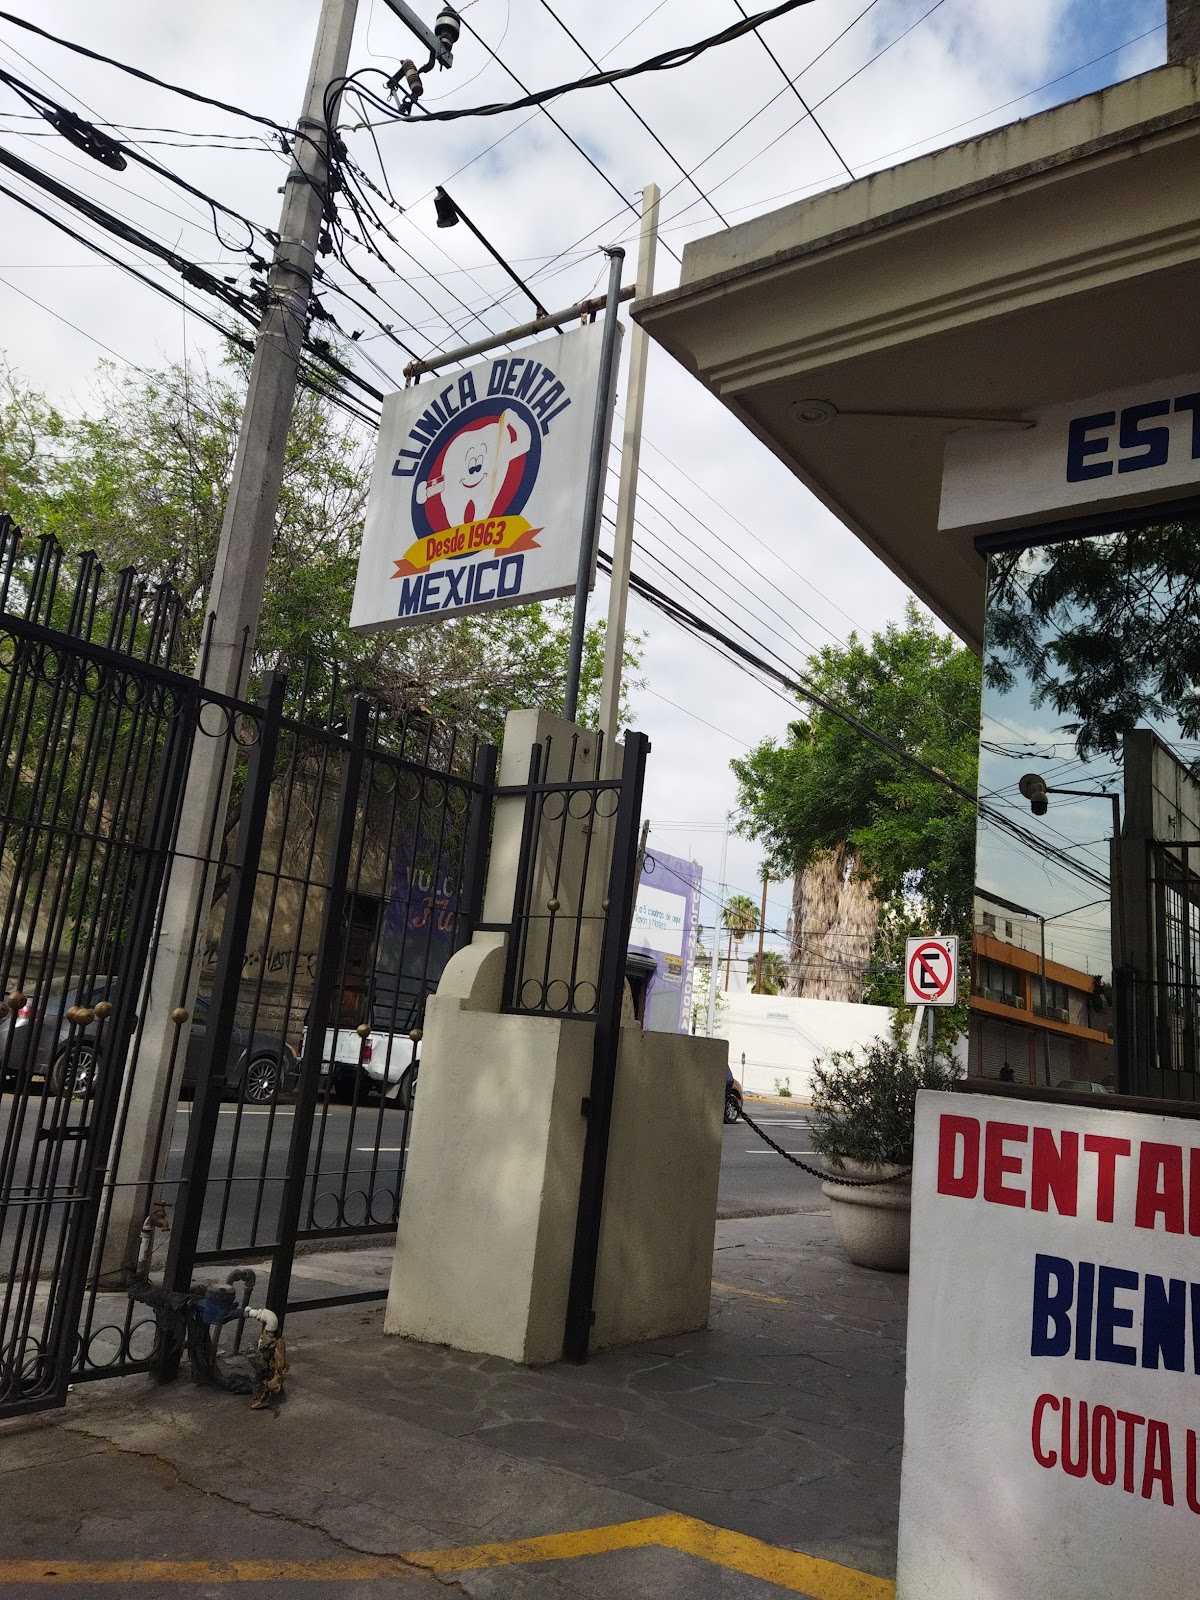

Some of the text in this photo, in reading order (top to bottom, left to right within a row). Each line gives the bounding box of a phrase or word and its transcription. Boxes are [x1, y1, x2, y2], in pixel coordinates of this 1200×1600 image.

[392, 358, 572, 477] CLINICA DENTAL
[398, 554, 525, 617] MEXICO
[426, 520, 507, 561] Desde 1963
[920, 953, 940, 988] E
[937, 1113, 1200, 1237] DENTA
[1030, 1253, 1200, 1376] BIEN
[1031, 1393, 1174, 1506] CUOTA
